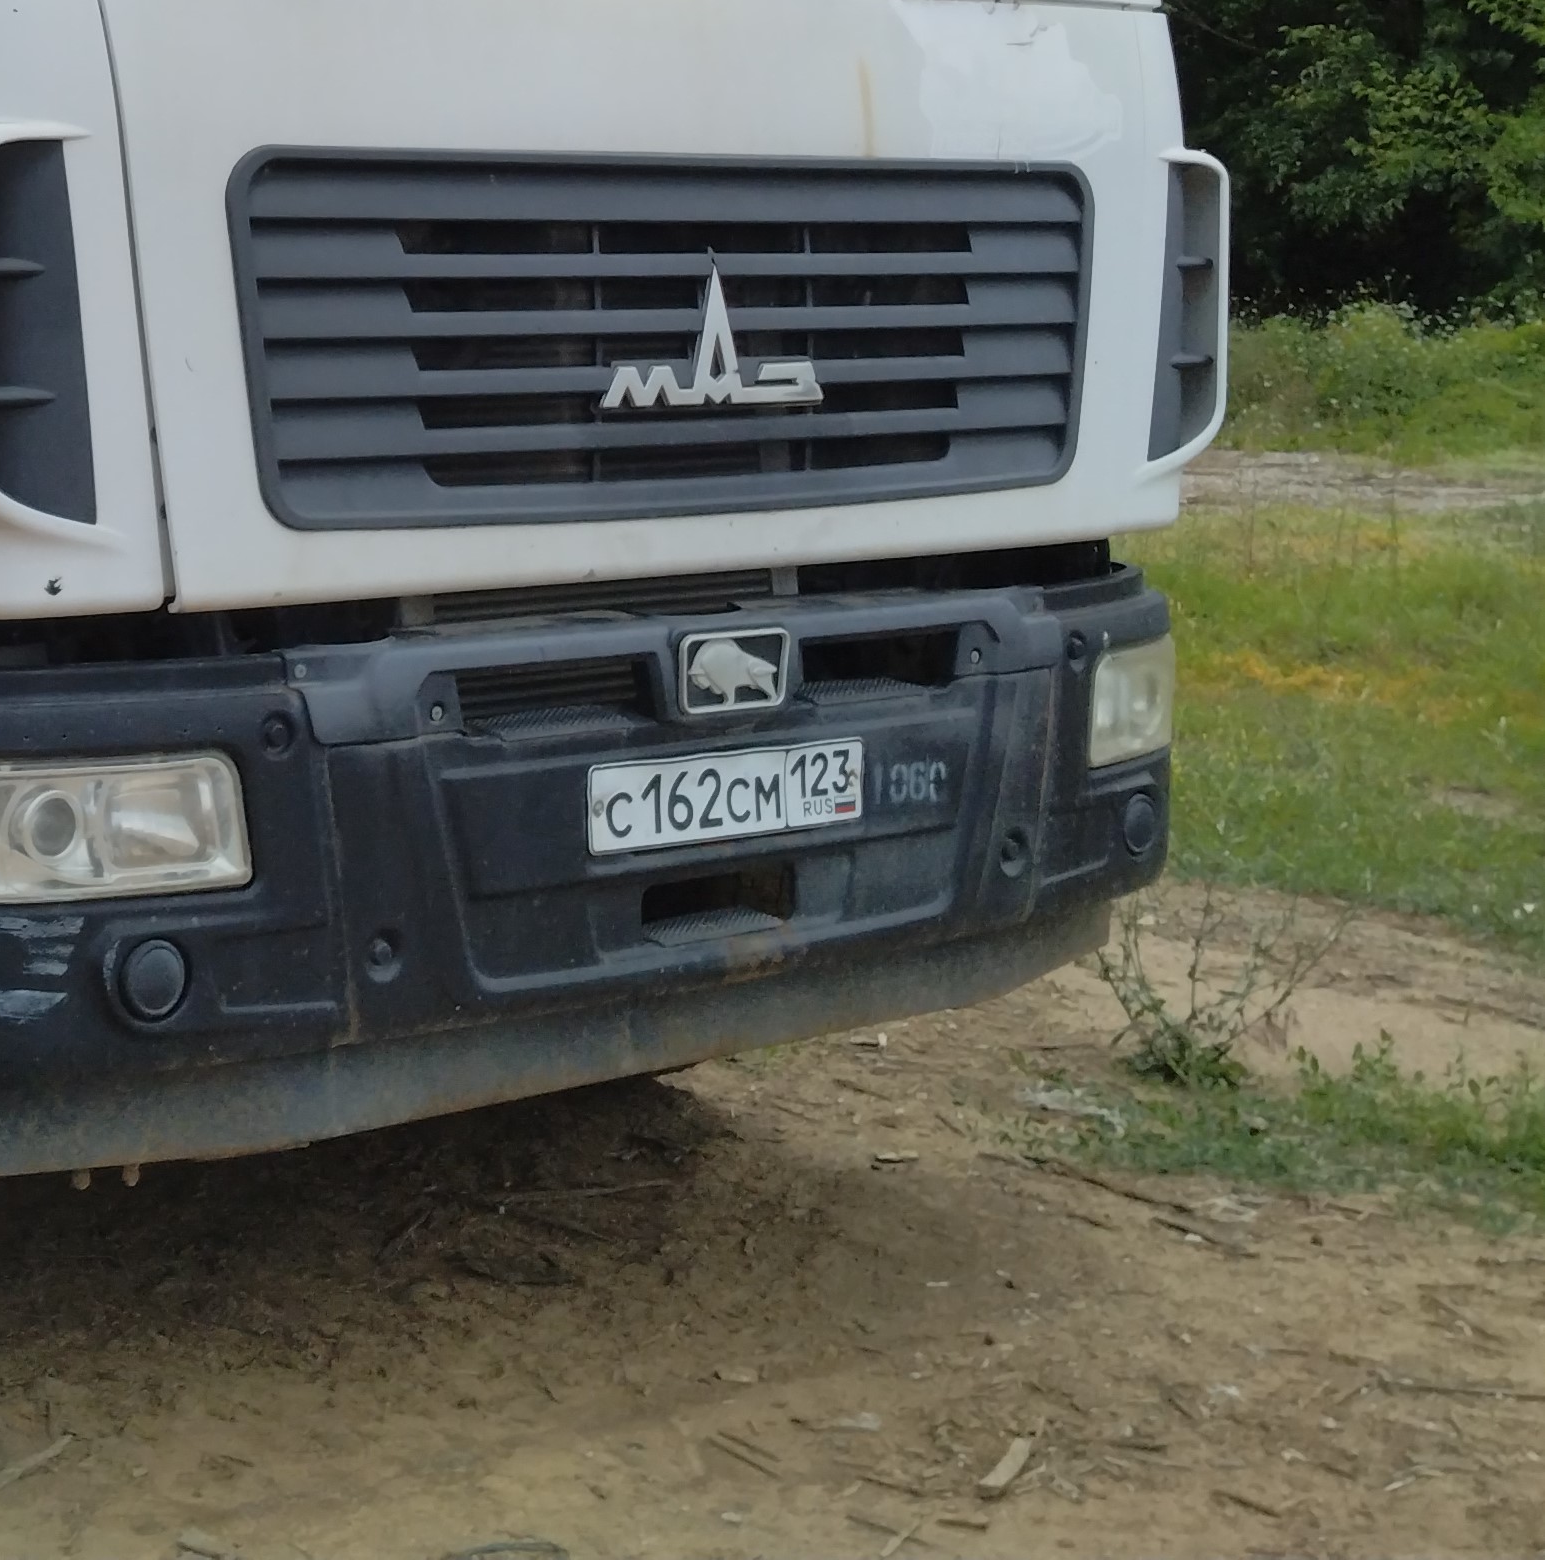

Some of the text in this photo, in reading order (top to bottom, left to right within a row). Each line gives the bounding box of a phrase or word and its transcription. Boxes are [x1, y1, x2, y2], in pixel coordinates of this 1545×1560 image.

[600, 246, 824, 408] МАЗ
[605, 748, 852, 839] С162СМ 123
[803, 797, 834, 818] RUS
